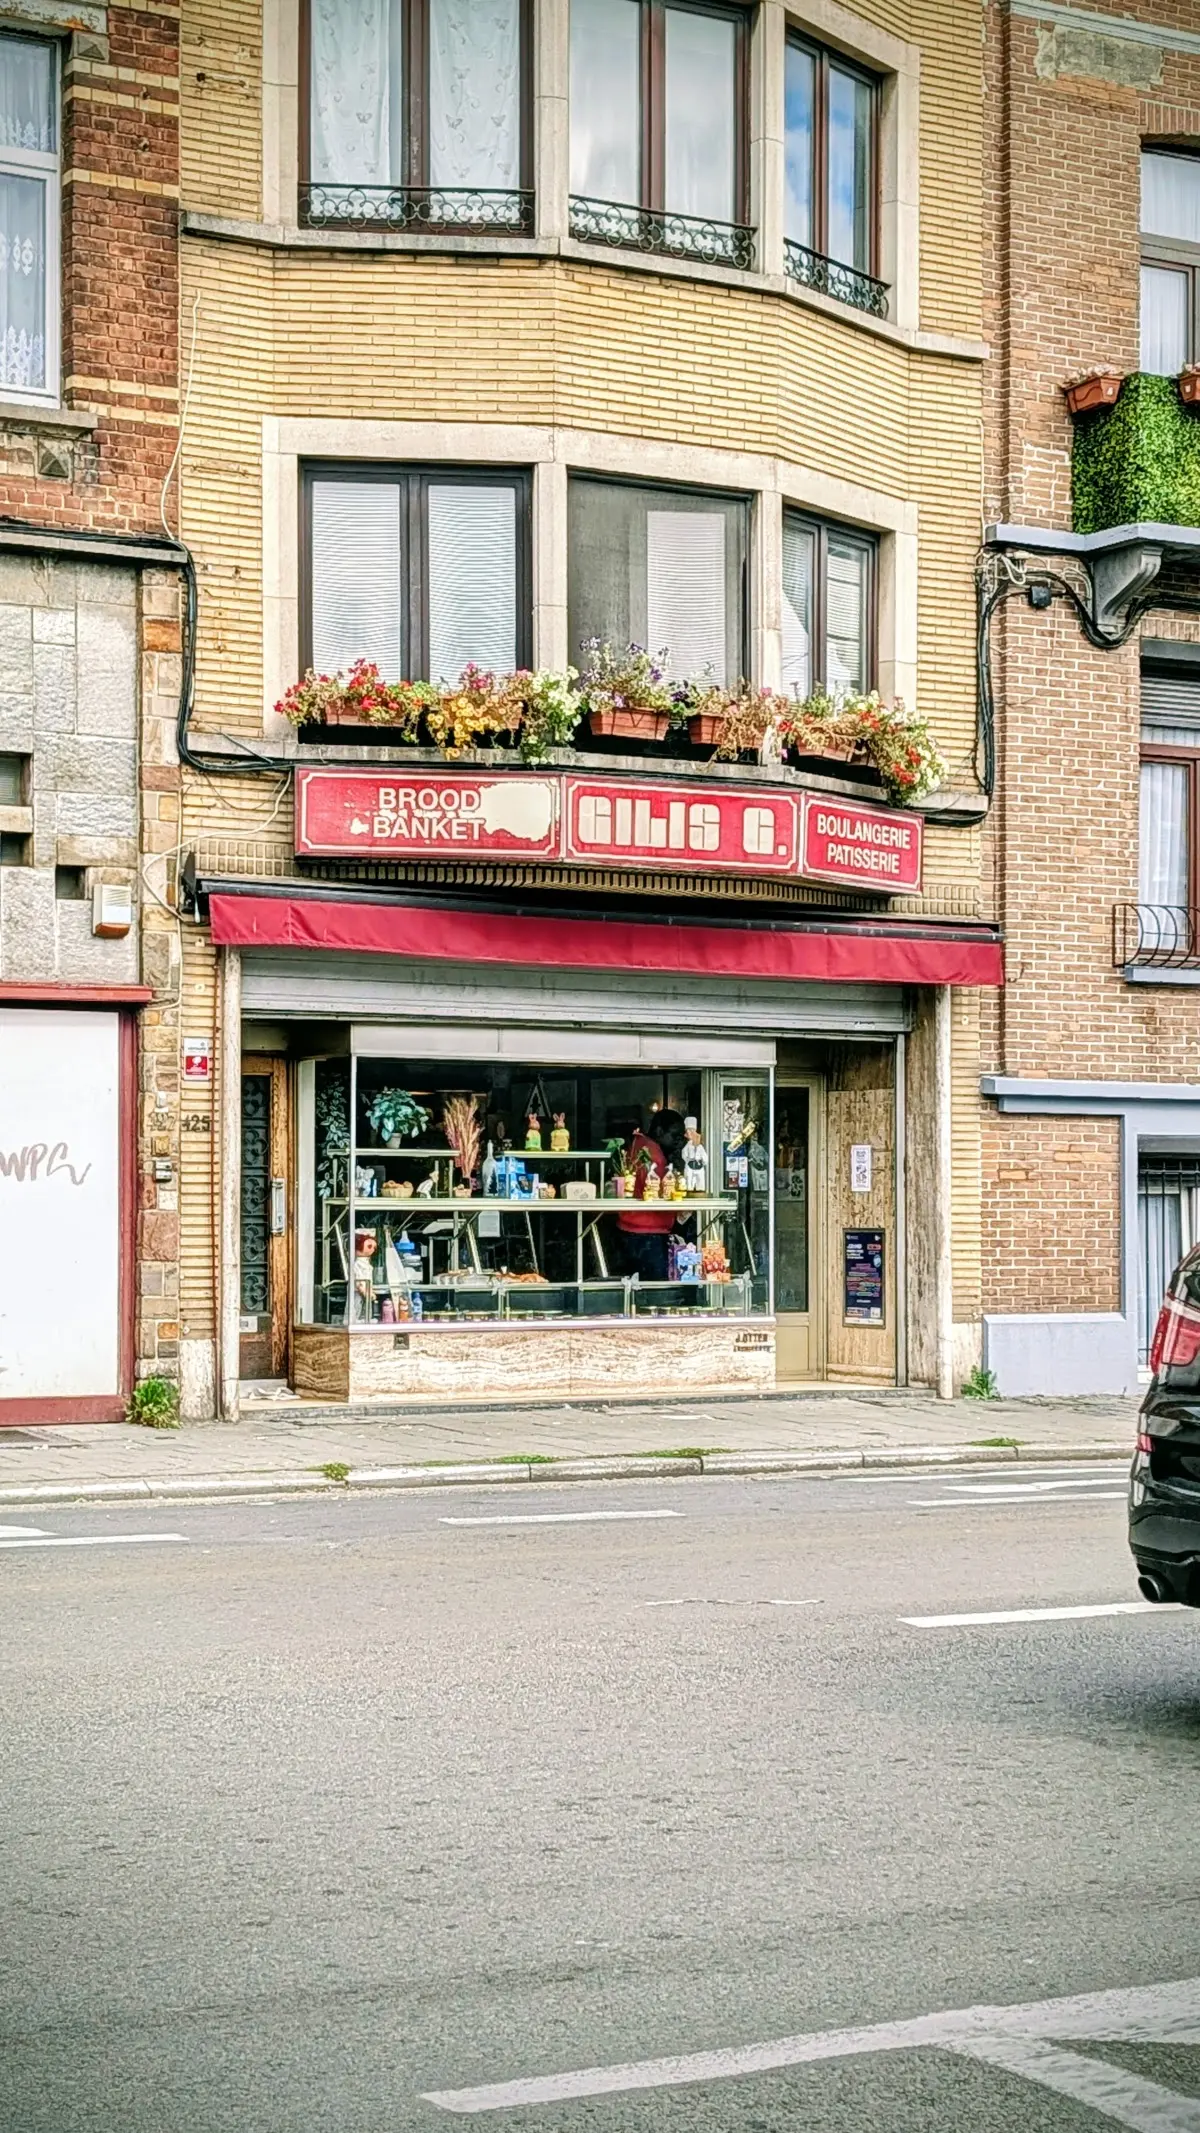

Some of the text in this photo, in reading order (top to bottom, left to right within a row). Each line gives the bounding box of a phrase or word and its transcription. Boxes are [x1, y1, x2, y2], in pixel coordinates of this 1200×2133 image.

[379, 787, 481, 811] BROOD
[373, 816, 484, 841] BANKET
[577, 795, 721, 852] GILIS
[817, 813, 911, 850] BOULANGERIE
[827, 842, 900, 874] PATISSERIE
